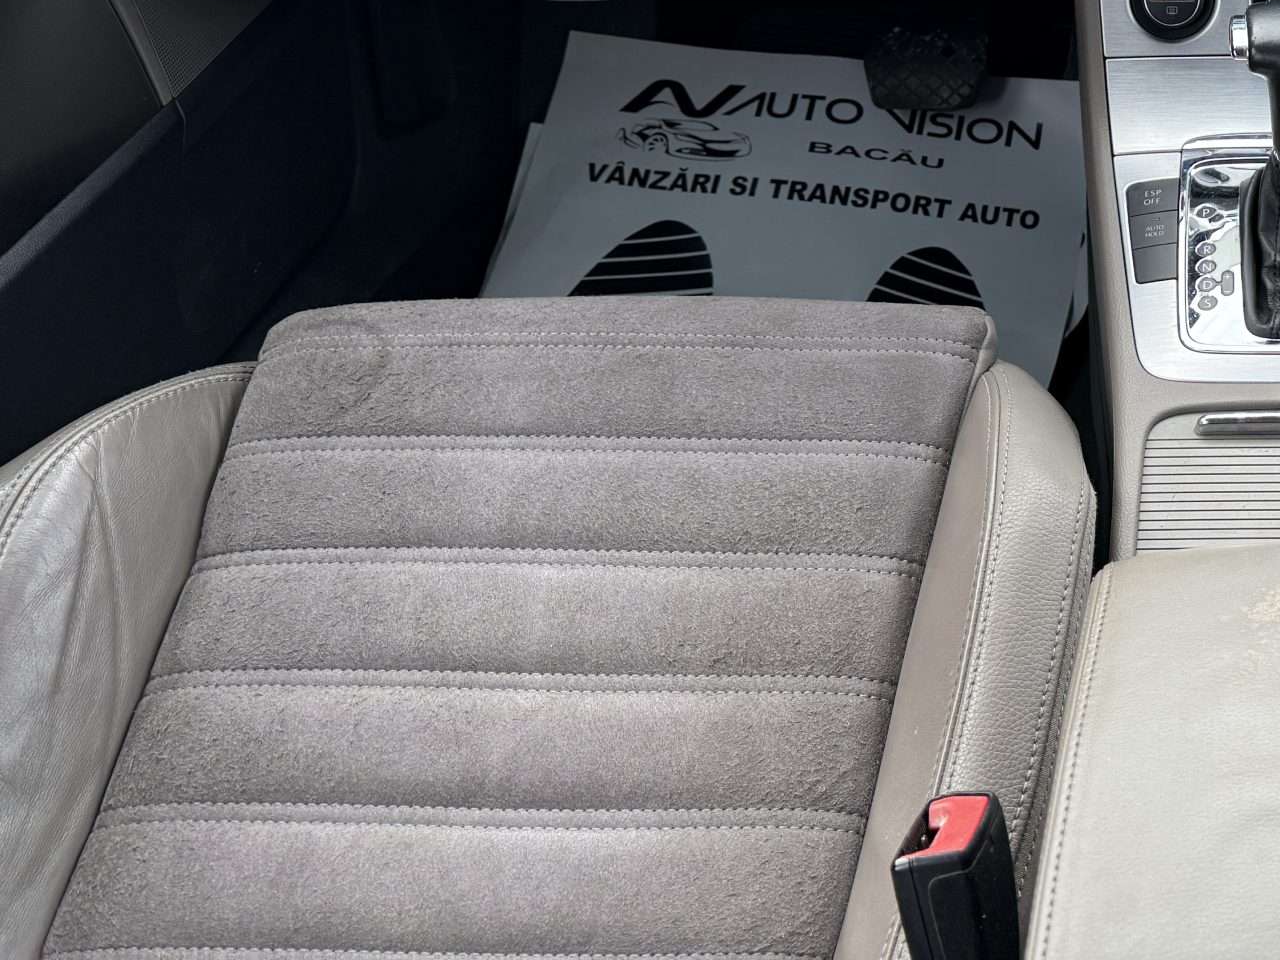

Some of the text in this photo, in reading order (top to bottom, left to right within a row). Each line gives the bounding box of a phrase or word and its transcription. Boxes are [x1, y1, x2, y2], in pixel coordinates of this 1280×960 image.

[723, 91, 865, 125] AUTO
[808, 140, 945, 169] BACĂU
[587, 162, 1041, 231] VÂNZĂRI SI TRANSPORT AUTO
[1144, 189, 1162, 198] ESP
[1143, 197, 1161, 206] OFF
[1202, 208, 1210, 217] P
[1145, 230, 1165, 238] HOLD
[1203, 245, 1212, 254] R
[1202, 263, 1212, 271] N
[1202, 280, 1212, 289] D
[1204, 299, 1212, 308] S
